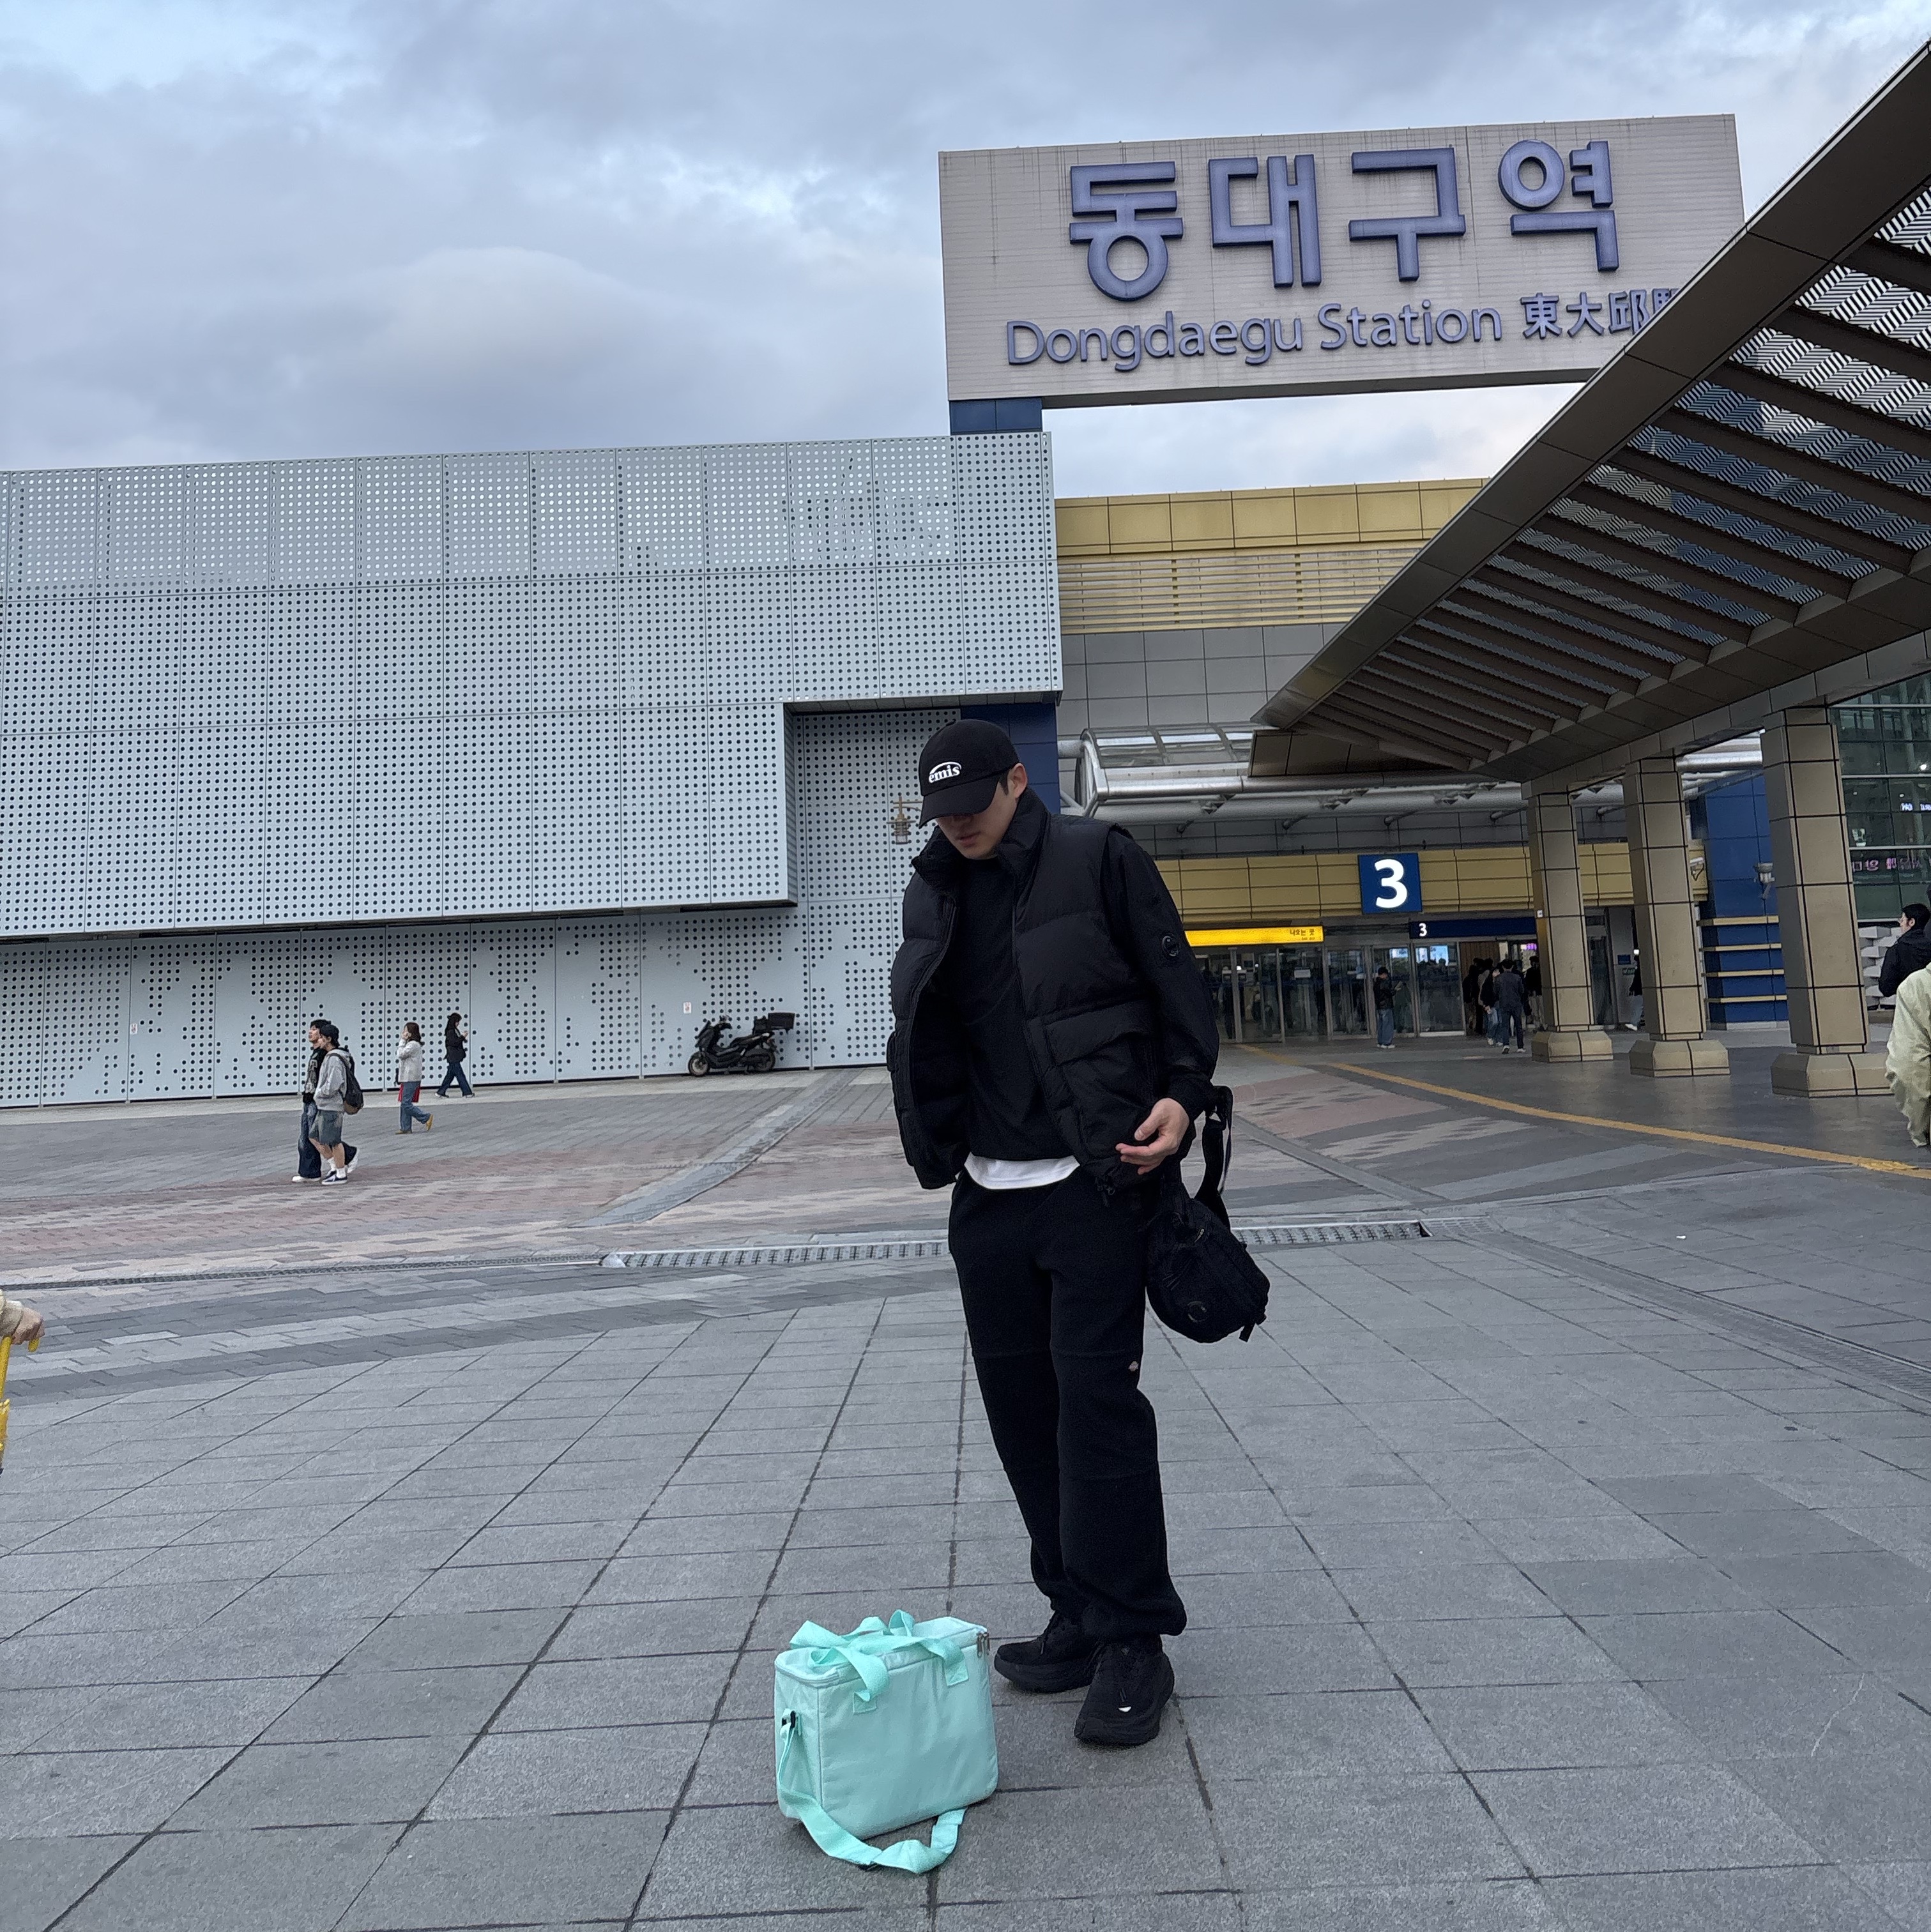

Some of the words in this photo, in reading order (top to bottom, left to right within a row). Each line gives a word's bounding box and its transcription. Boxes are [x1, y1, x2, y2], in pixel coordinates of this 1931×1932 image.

[1069, 140, 1619, 301] 동대구역
[1007, 310, 1302, 372] Dongdaegu
[1318, 300, 1502, 350] Station
[1520, 288, 1681, 340] 東大邱
[929, 765, 960, 783] emis
[1373, 858, 1408, 908] 3
[1419, 922, 1427, 937] 3
